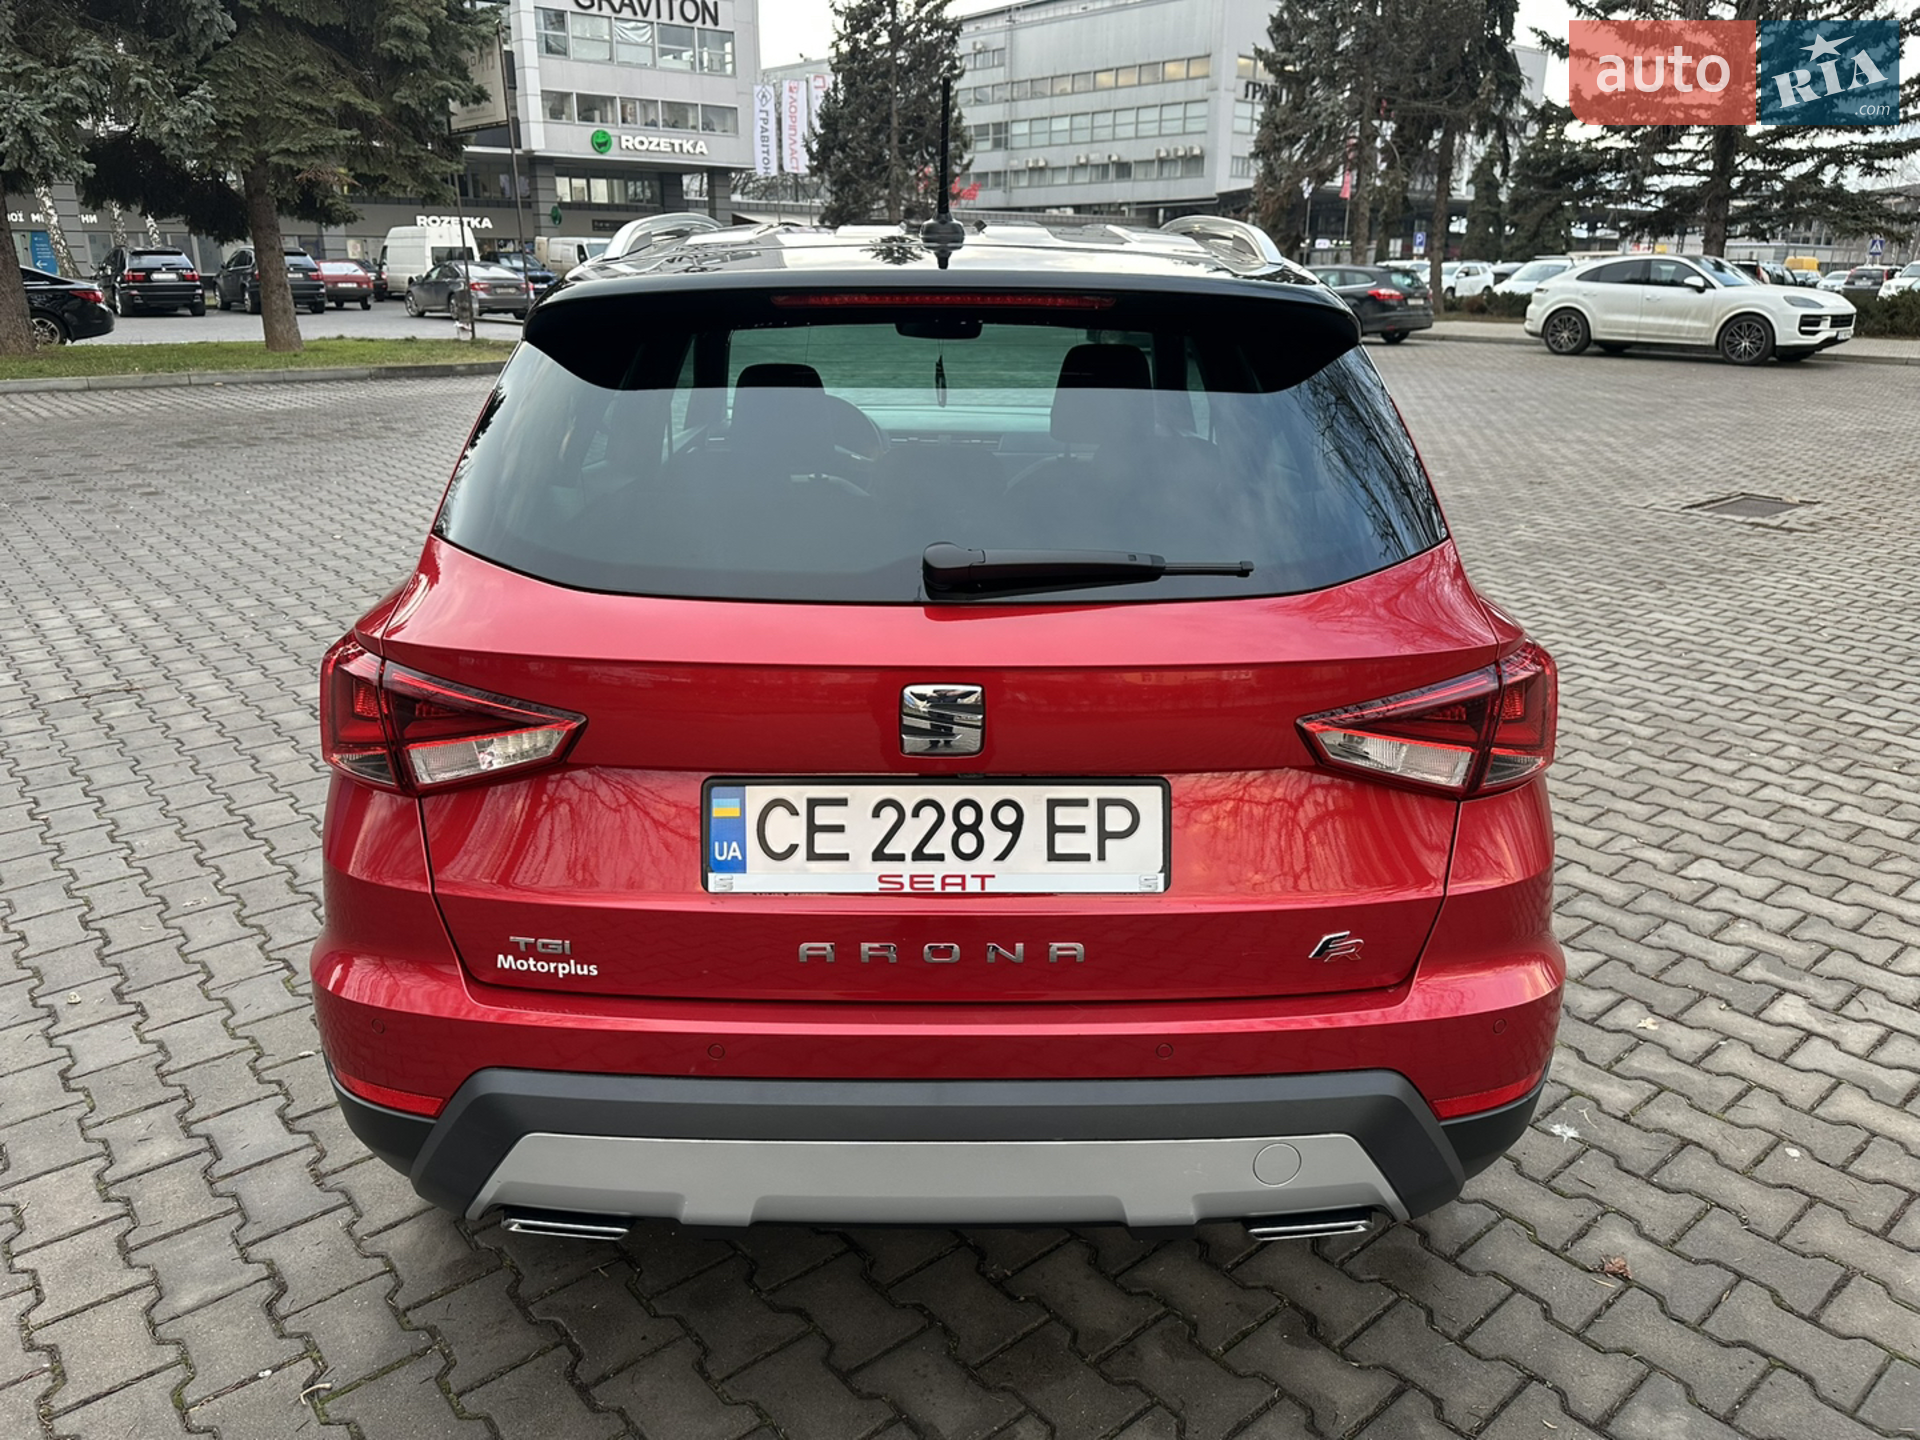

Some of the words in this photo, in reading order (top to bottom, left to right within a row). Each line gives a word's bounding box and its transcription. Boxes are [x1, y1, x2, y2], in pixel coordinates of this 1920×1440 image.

[620, 135, 709, 155] ROZETKA
[758, 109, 771, 176] ГРАВІТОН
[416, 215, 493, 229] ROZETKA
[756, 798, 850, 862] CE
[871, 798, 1025, 862] 2289
[1046, 798, 1141, 862] EP
[714, 841, 742, 861] UA
[877, 873, 996, 892] SEAT
[509, 936, 571, 955] TGI
[798, 942, 1086, 964] ARONA
[497, 954, 599, 978] Motorplus
